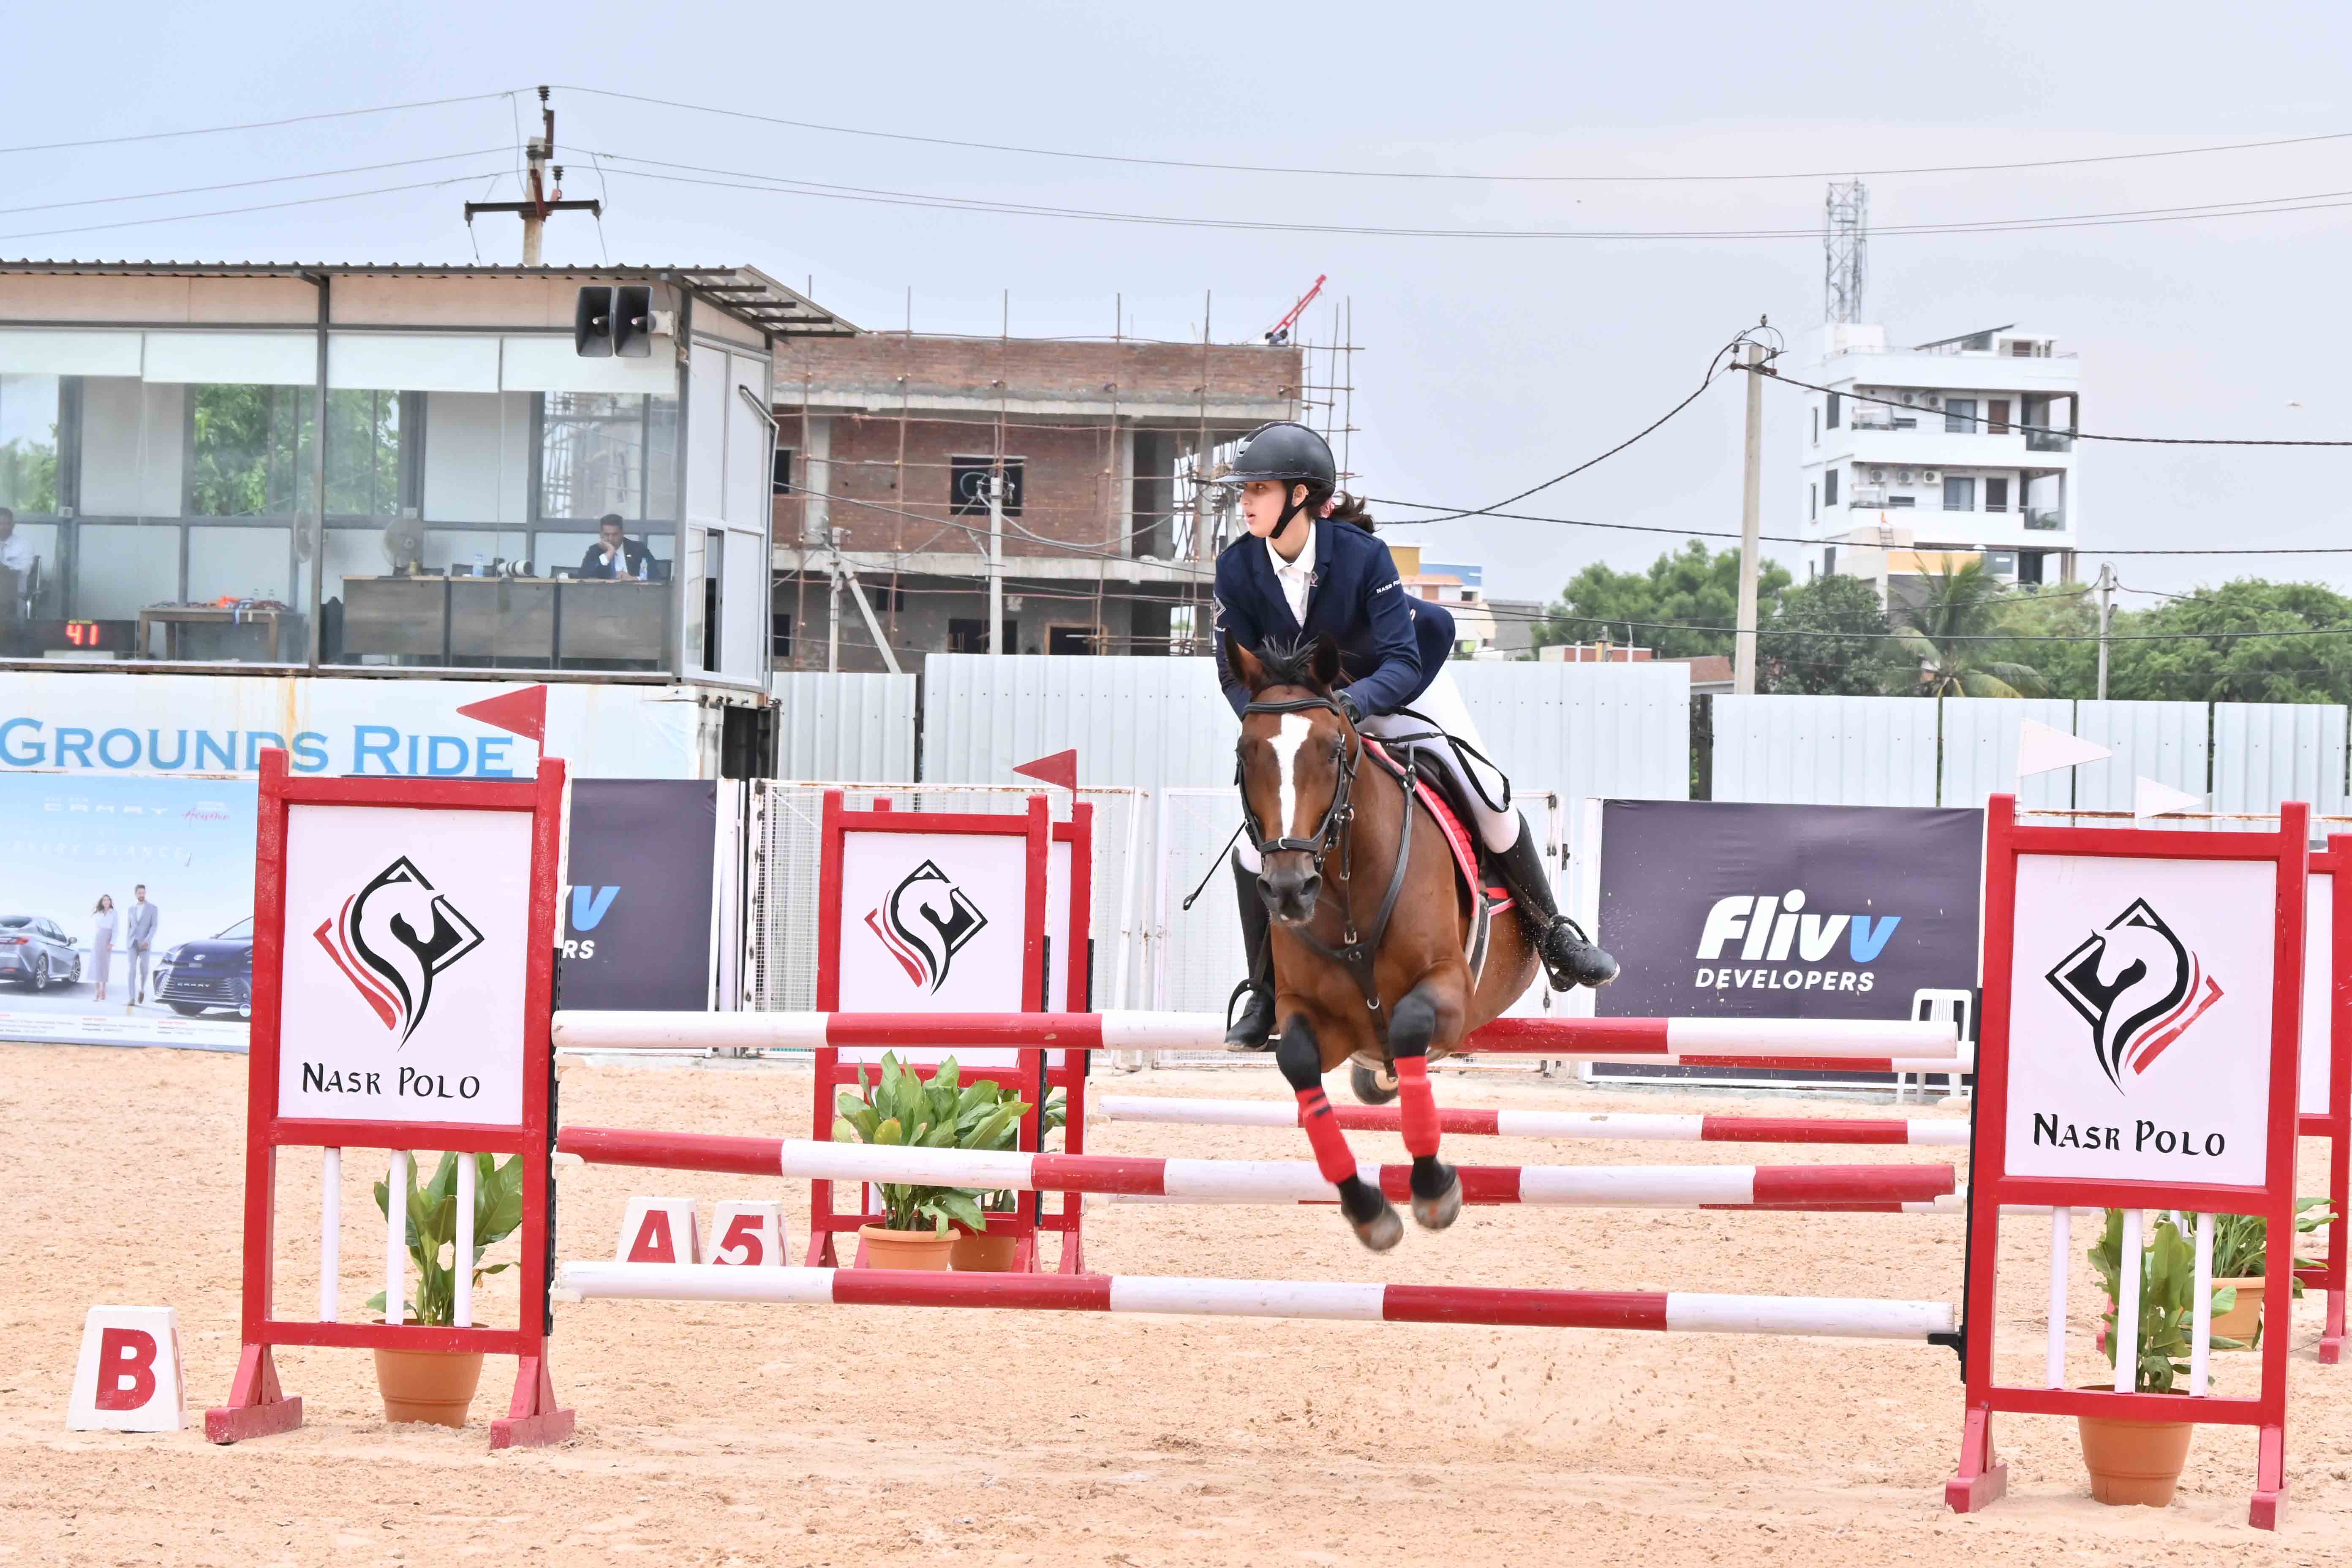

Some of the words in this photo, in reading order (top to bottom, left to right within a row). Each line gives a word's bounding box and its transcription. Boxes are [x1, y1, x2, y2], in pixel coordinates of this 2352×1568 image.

[66, 624, 99, 645] 41
[0, 717, 329, 773] GROUNDS
[351, 725, 514, 777] RIDE
[1695, 968, 1874, 991] DEVELOPERS
[302, 1062, 381, 1095] NASR
[398, 1067, 480, 1099] POLO
[2033, 1113, 2120, 1151] NASR
[2135, 1120, 2225, 1156] POLO
[626, 1210, 676, 1263] A
[713, 1214, 763, 1266] 5
[95, 1328, 157, 1411] B
